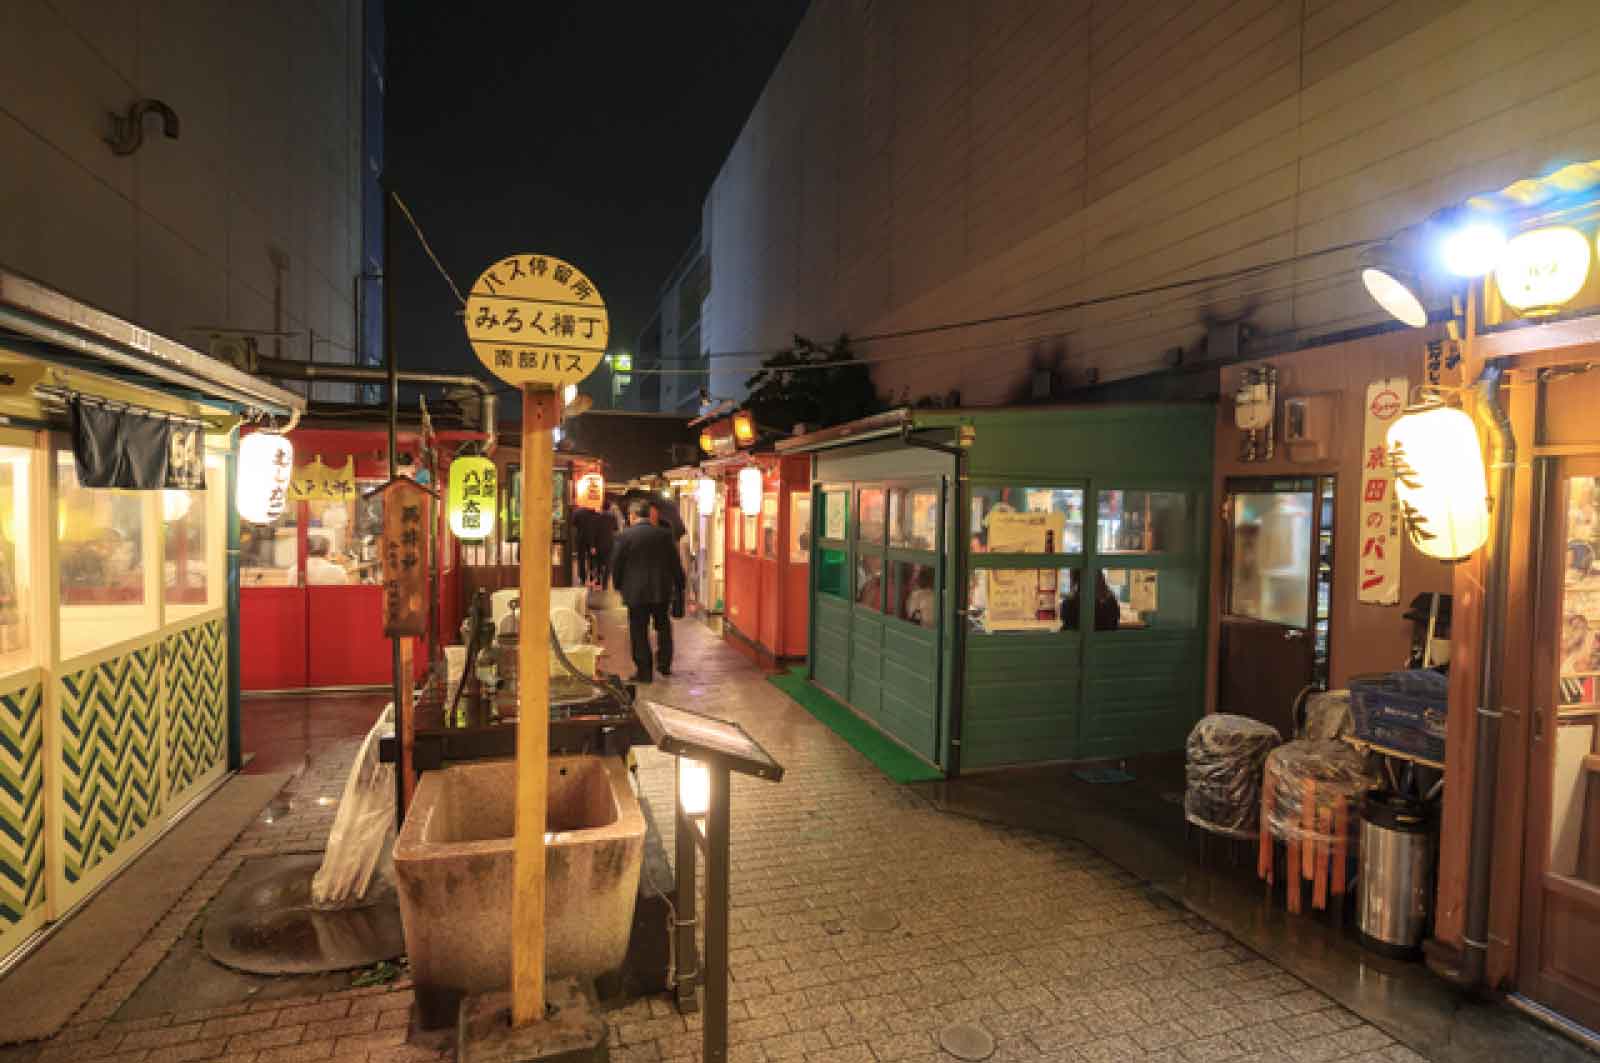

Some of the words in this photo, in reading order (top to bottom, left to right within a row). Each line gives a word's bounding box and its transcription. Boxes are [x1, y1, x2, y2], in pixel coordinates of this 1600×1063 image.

[481, 256, 593, 300] バス停留所
[475, 306, 602, 340] みろく横丁
[494, 349, 584, 373] 南部バス
